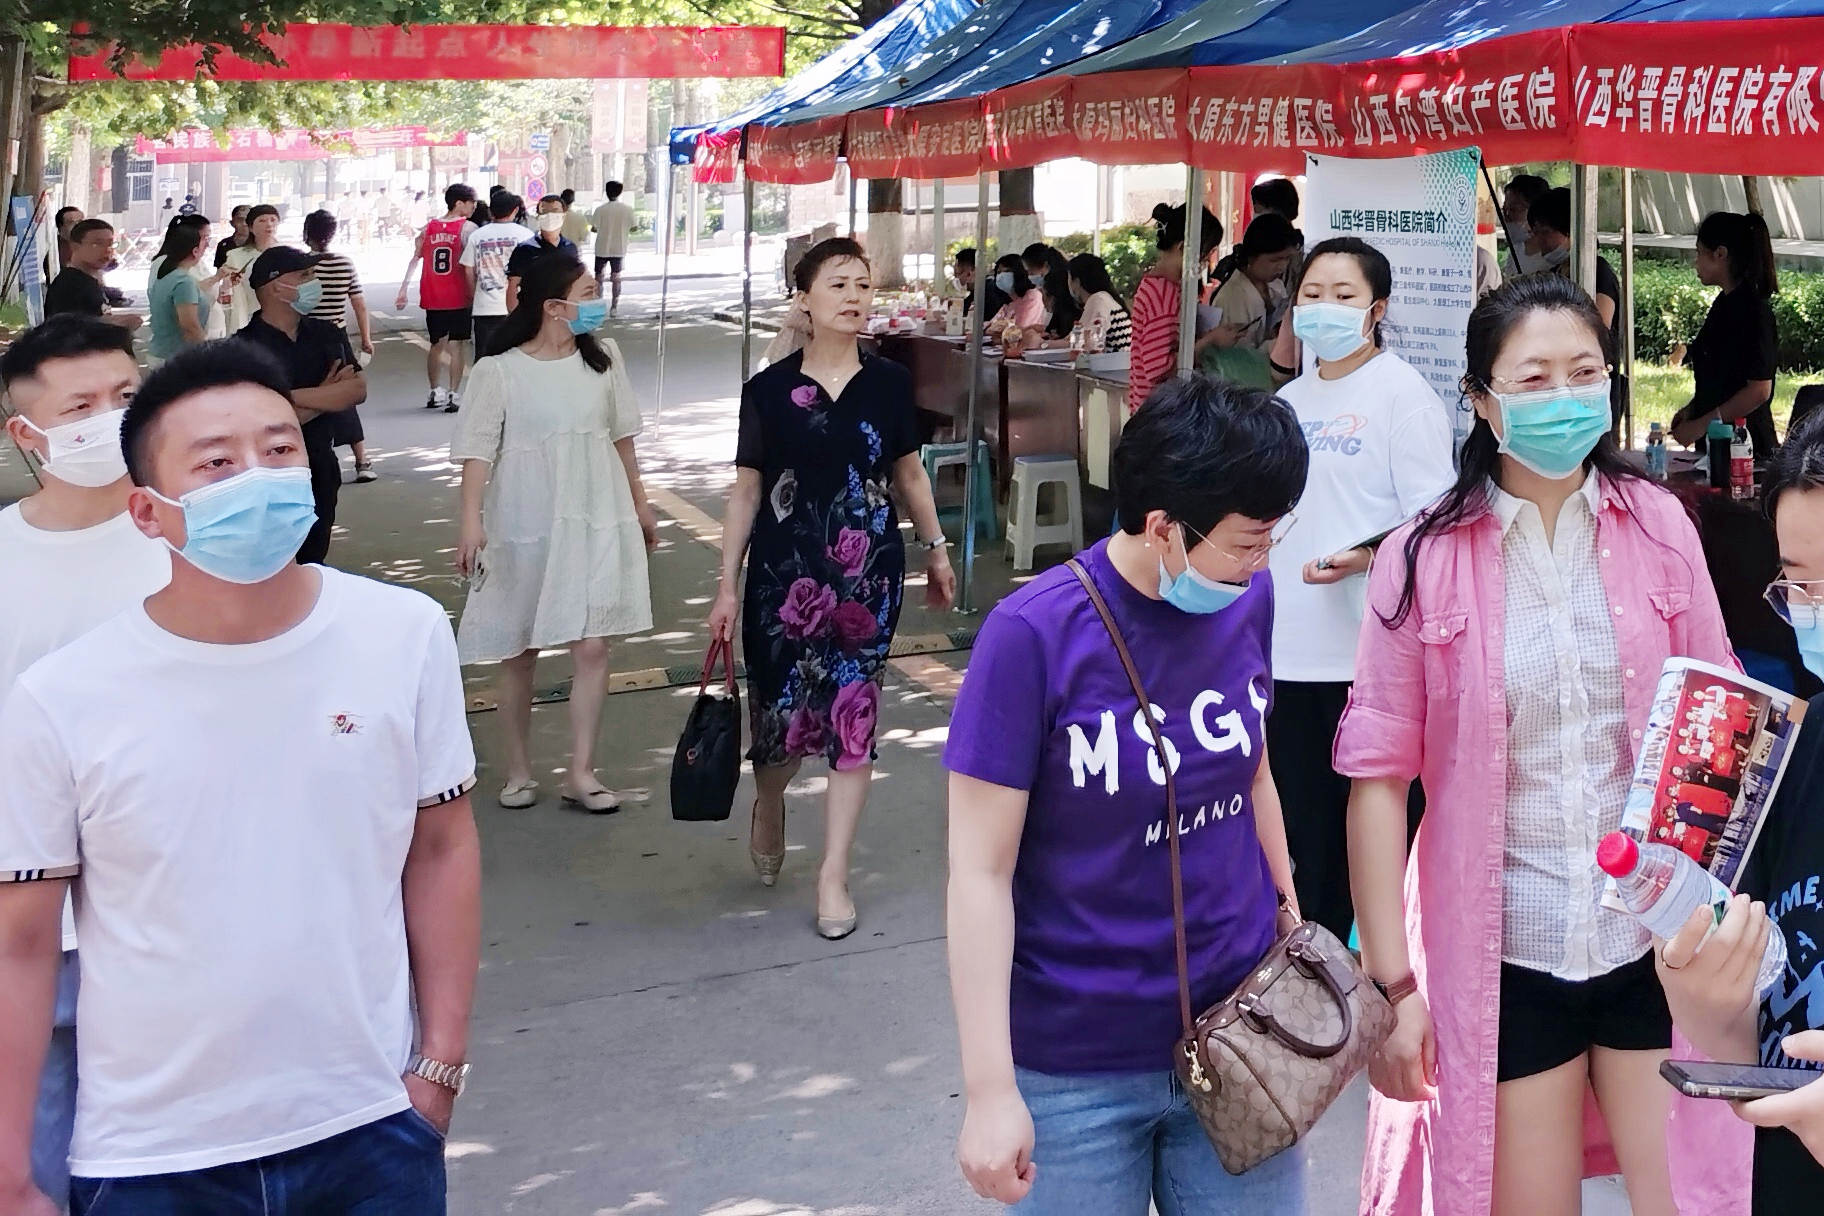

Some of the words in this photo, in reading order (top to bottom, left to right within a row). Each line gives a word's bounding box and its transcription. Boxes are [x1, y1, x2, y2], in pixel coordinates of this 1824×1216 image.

[1350, 65, 1557, 147] 山西尔湾妇产医院
[1330, 208, 1448, 234] 山西华晋骨科医院简介
[433, 247, 452, 275] 8
[1145, 793, 1243, 846] MILANO
